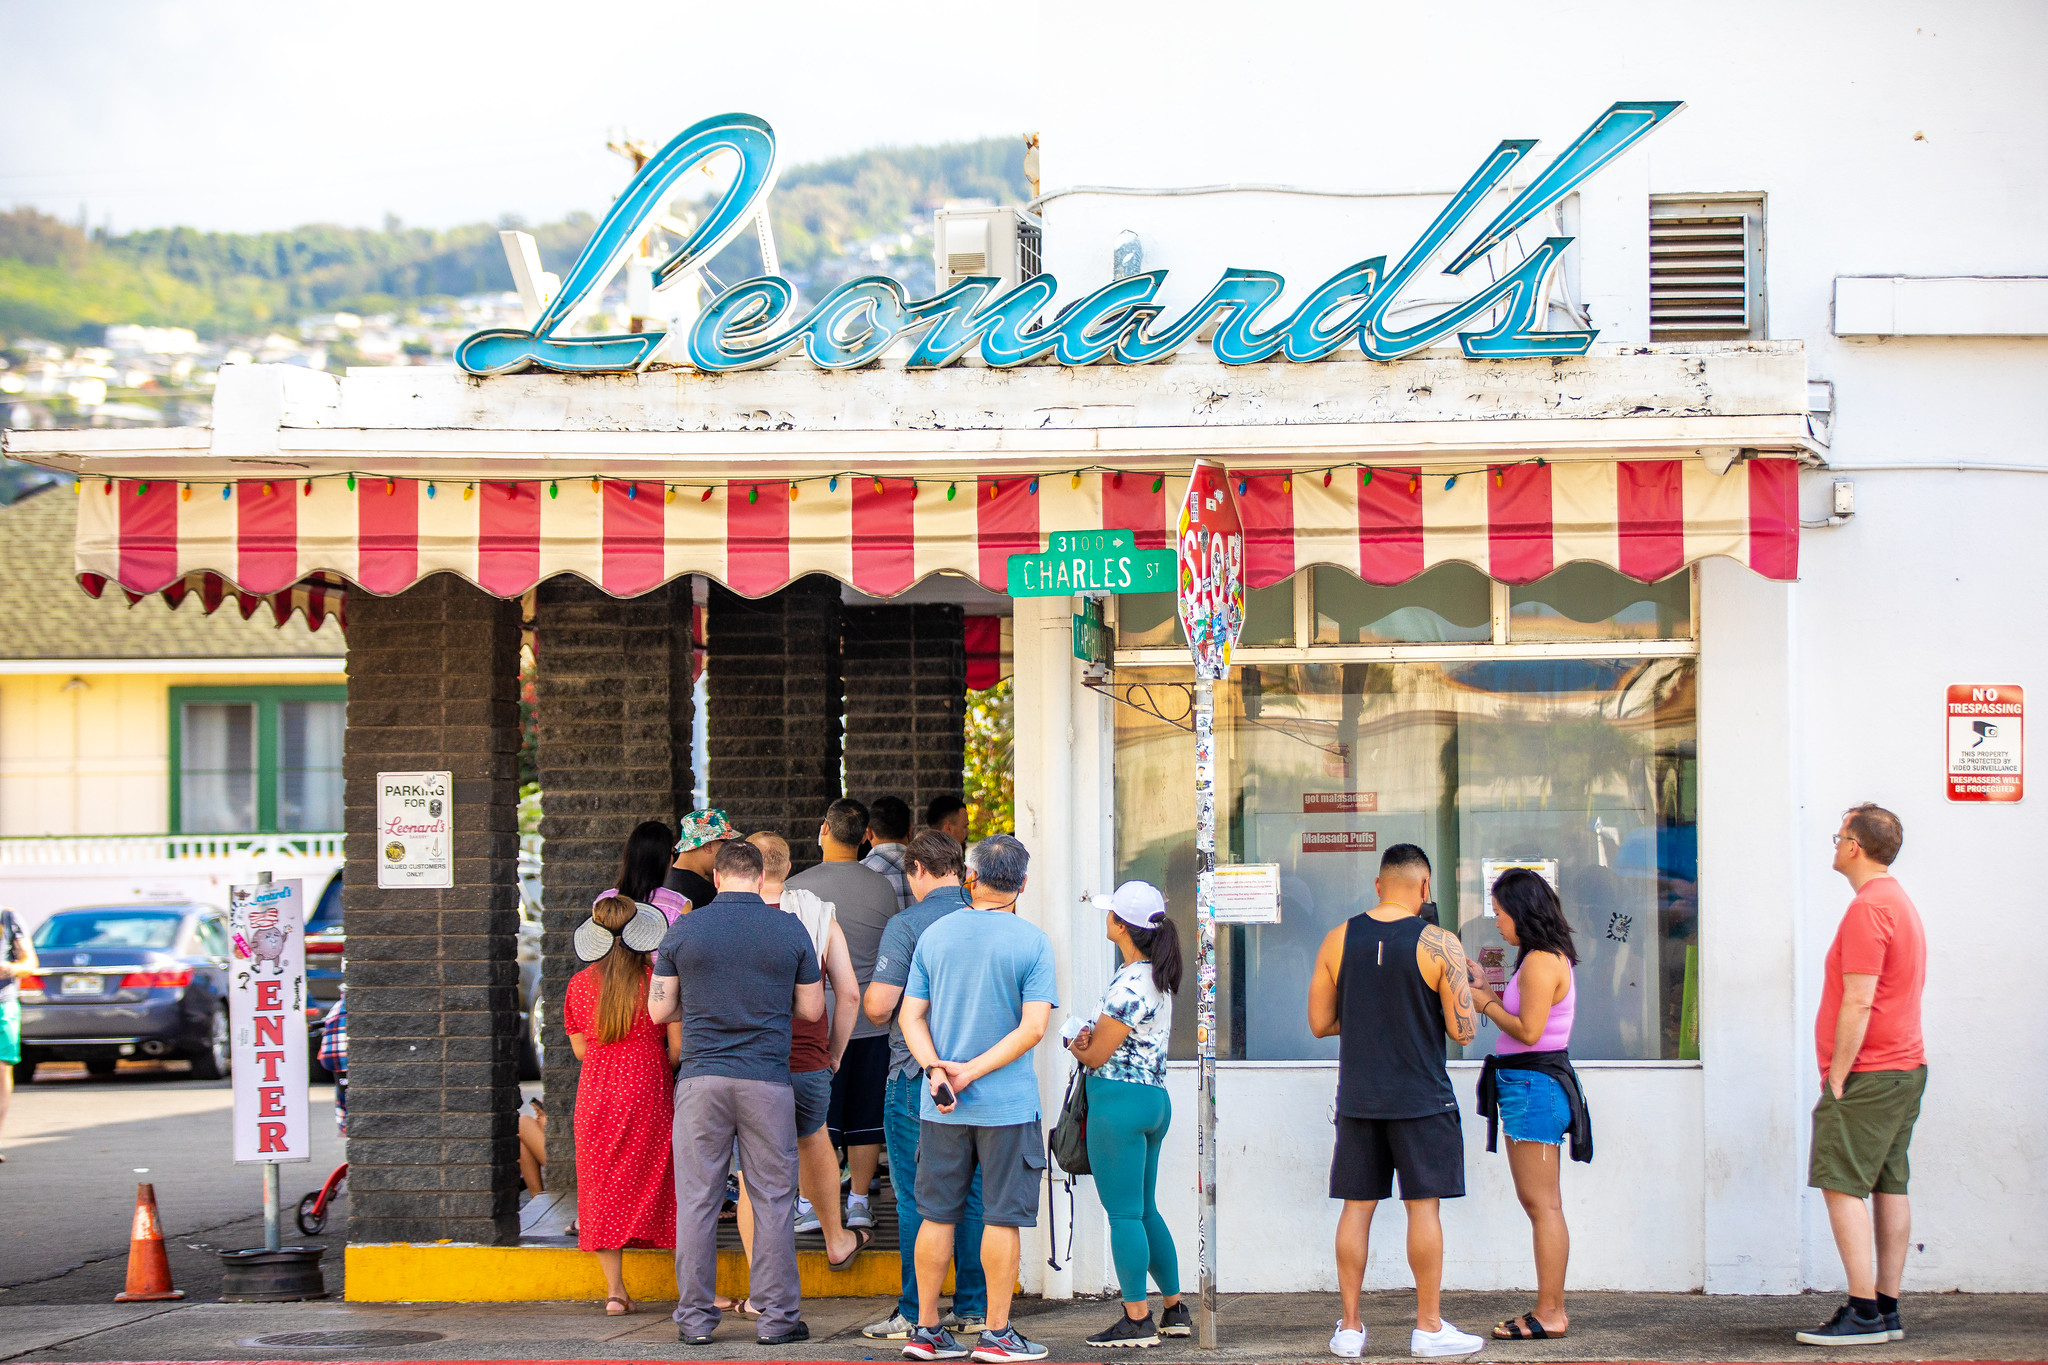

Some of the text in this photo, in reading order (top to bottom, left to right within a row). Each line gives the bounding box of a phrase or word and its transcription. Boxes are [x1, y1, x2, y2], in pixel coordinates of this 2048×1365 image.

[453, 101, 1686, 376] Leonard's
[1058, 536, 1104, 552] 3100
[1023, 557, 1160, 590] CHARLES ST
[1972, 688, 1998, 702] NO
[1949, 703, 2021, 714] TRESPASSING
[1950, 776, 2000, 784] TRESPASSERS
[1955, 785, 1965, 793] BE
[404, 799, 425, 807] FOR
[1305, 793, 1374, 804] got malasadas?
[385, 816, 445, 836] Leonard's
[1303, 832, 1374, 844] Malasada Puffs
[253, 980, 289, 1153] ENTER
